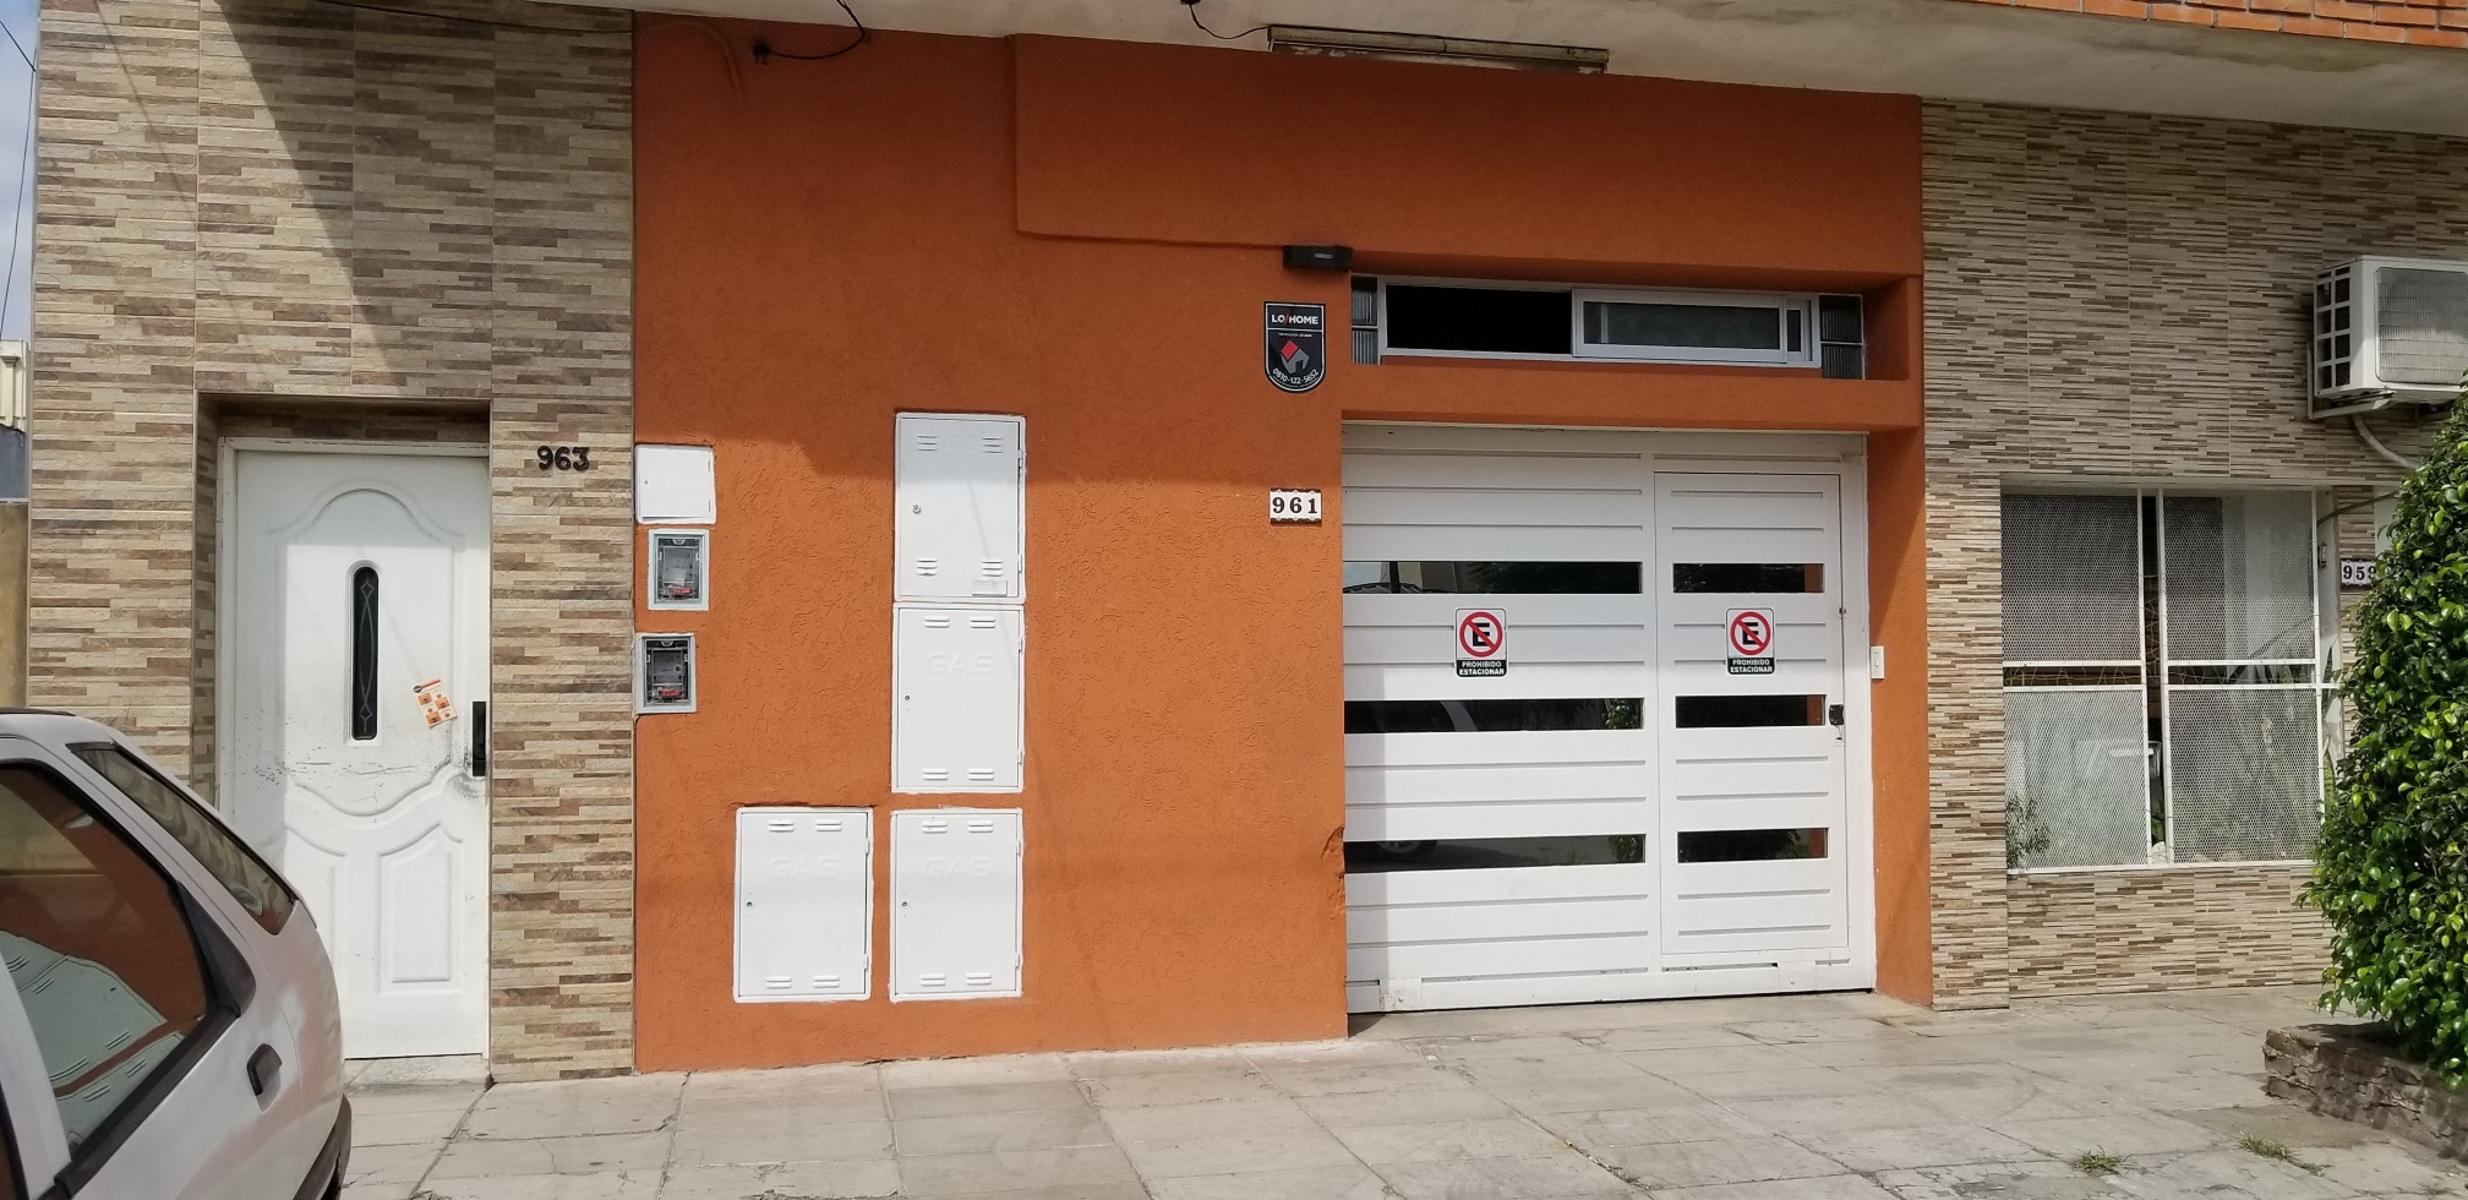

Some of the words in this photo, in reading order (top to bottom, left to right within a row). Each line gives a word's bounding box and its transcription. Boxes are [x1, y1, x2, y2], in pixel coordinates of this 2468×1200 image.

[537, 445, 590, 471] 963
[1272, 496, 1318, 514] 961
[2343, 565, 2377, 580] 959
[1472, 622, 1491, 647] E
[1742, 621, 1759, 645] E
[1462, 660, 1502, 668] PROHIBIDO
[1732, 658, 1770, 666] PROHIBIDO
[1459, 668, 1505, 676] ESTACIONAR
